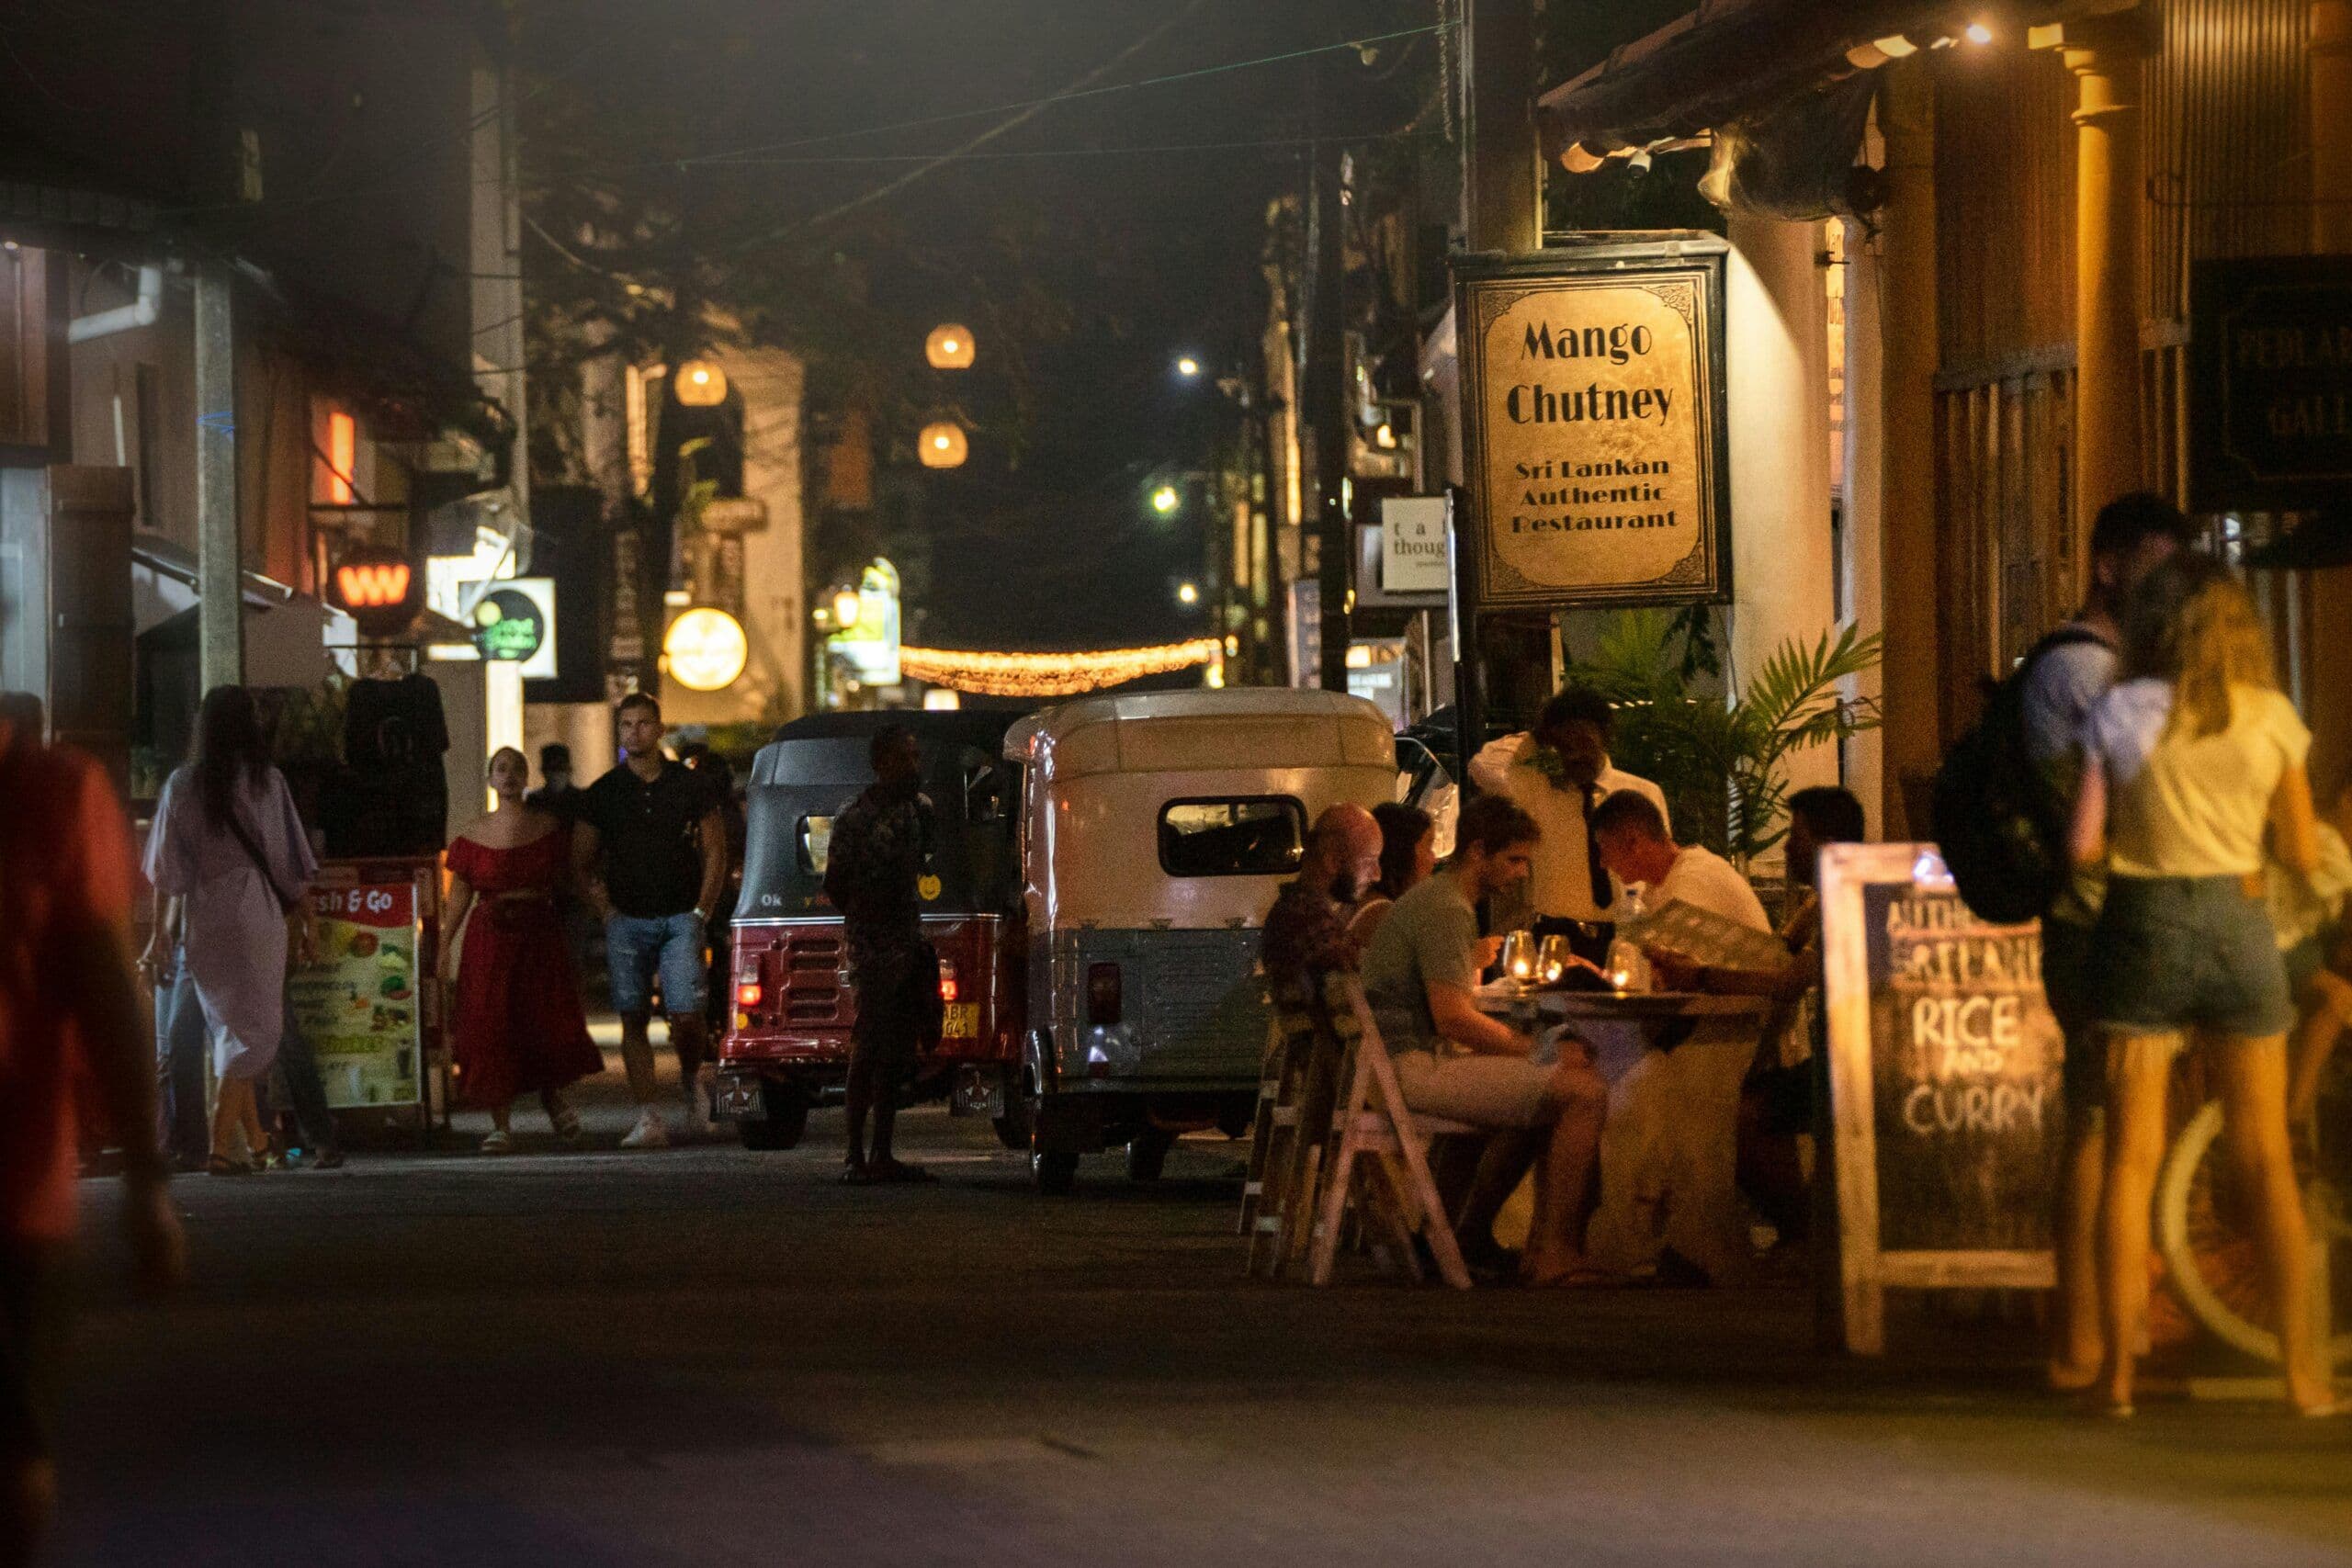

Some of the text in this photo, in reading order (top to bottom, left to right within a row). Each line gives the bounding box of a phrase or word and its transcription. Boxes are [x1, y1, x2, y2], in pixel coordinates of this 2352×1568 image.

[1521, 321, 1652, 365] Mango
[1507, 382, 1673, 426] Chutney
[1516, 459, 1669, 479] Sri Lankan
[1520, 482, 1668, 506] Authentic
[1511, 510, 1679, 534] Restaurant
[1394, 538, 1446, 558] thoug
[367, 889, 393, 914] Go
[1914, 995, 2020, 1047] RICE
[1904, 1083, 2045, 1135] CURRY
